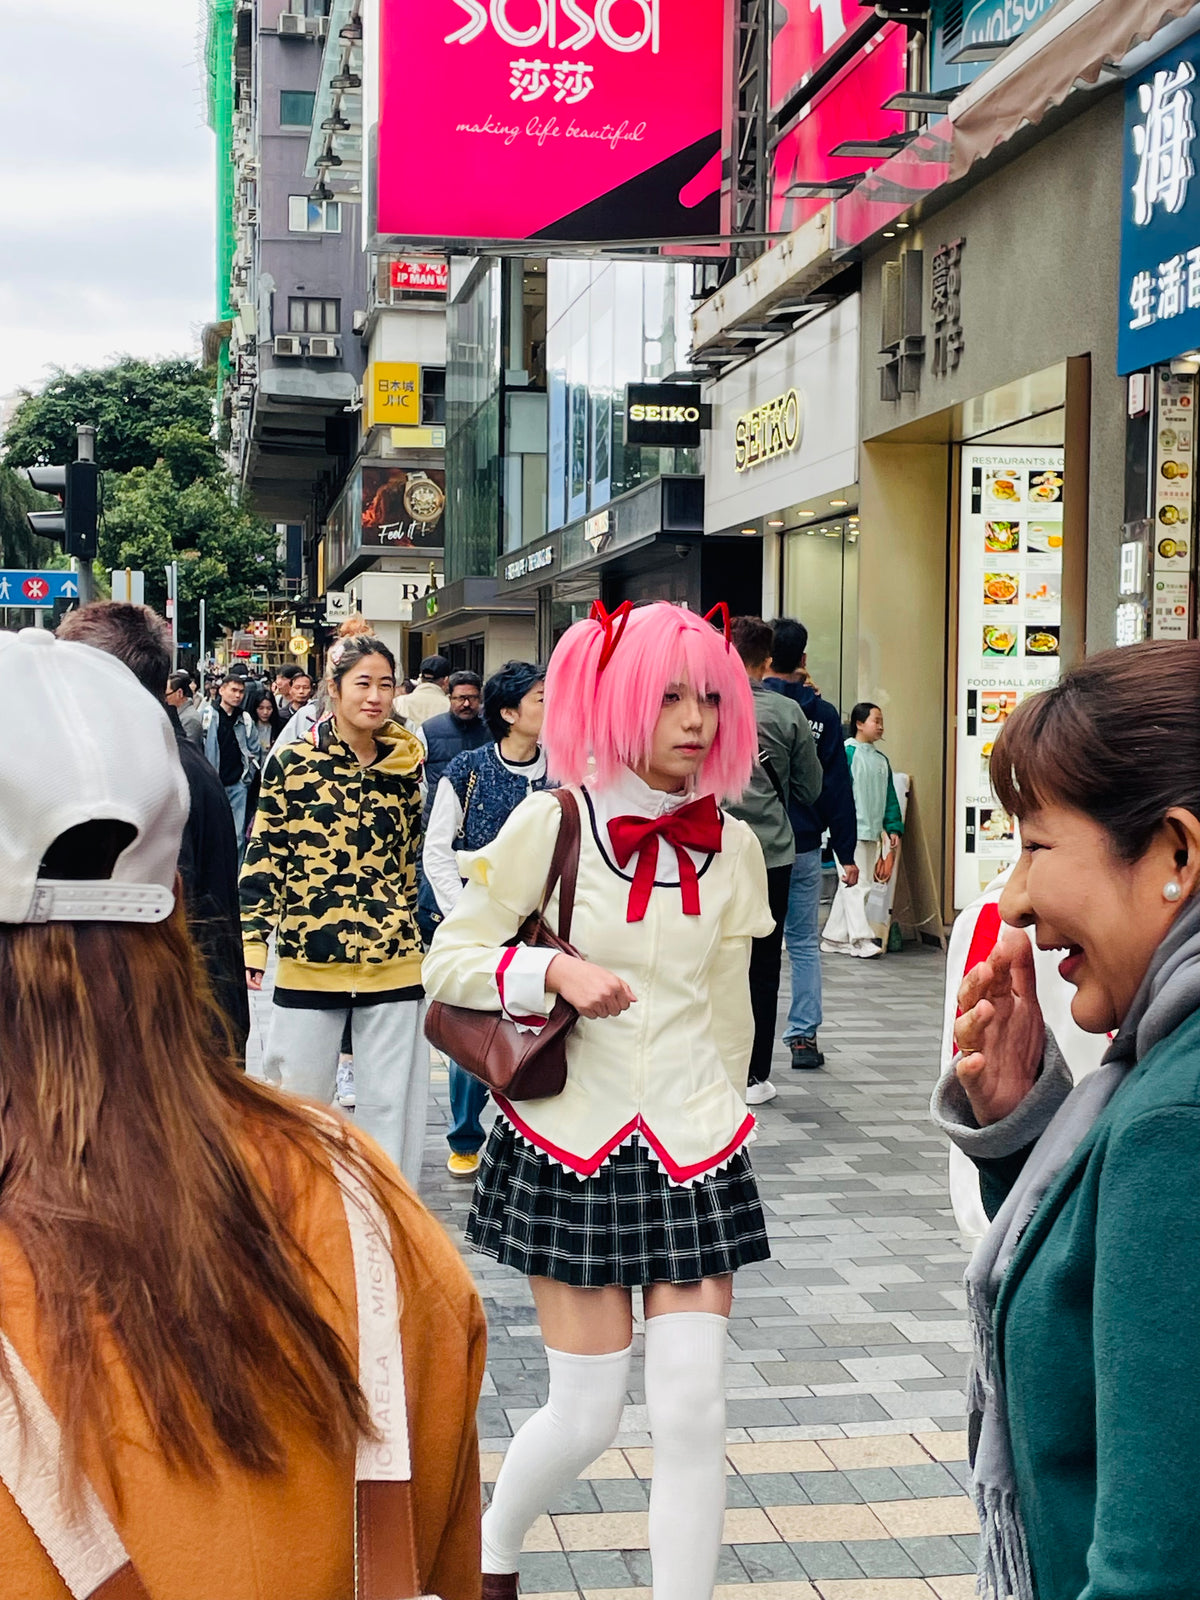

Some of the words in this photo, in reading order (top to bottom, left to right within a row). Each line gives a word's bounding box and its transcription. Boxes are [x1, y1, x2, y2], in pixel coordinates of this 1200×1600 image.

[508, 58, 594, 104] 莎莎
[455, 114, 522, 146] making
[525, 116, 561, 146] life
[565, 118, 647, 150] beautiful
[1132, 61, 1194, 225] 海
[397, 272, 408, 283] IP
[409, 273, 434, 285] MAN
[378, 380, 415, 392] 日本城
[382, 394, 409, 407] JHC
[629, 404, 700, 423] SEIKO
[734, 387, 801, 473] SEIKO
[972, 456, 1045, 466] RESTAURANTS
[1048, 457, 1055, 466] &
[967, 679, 996, 687] FOOD
[999, 679, 1024, 687] HALL
